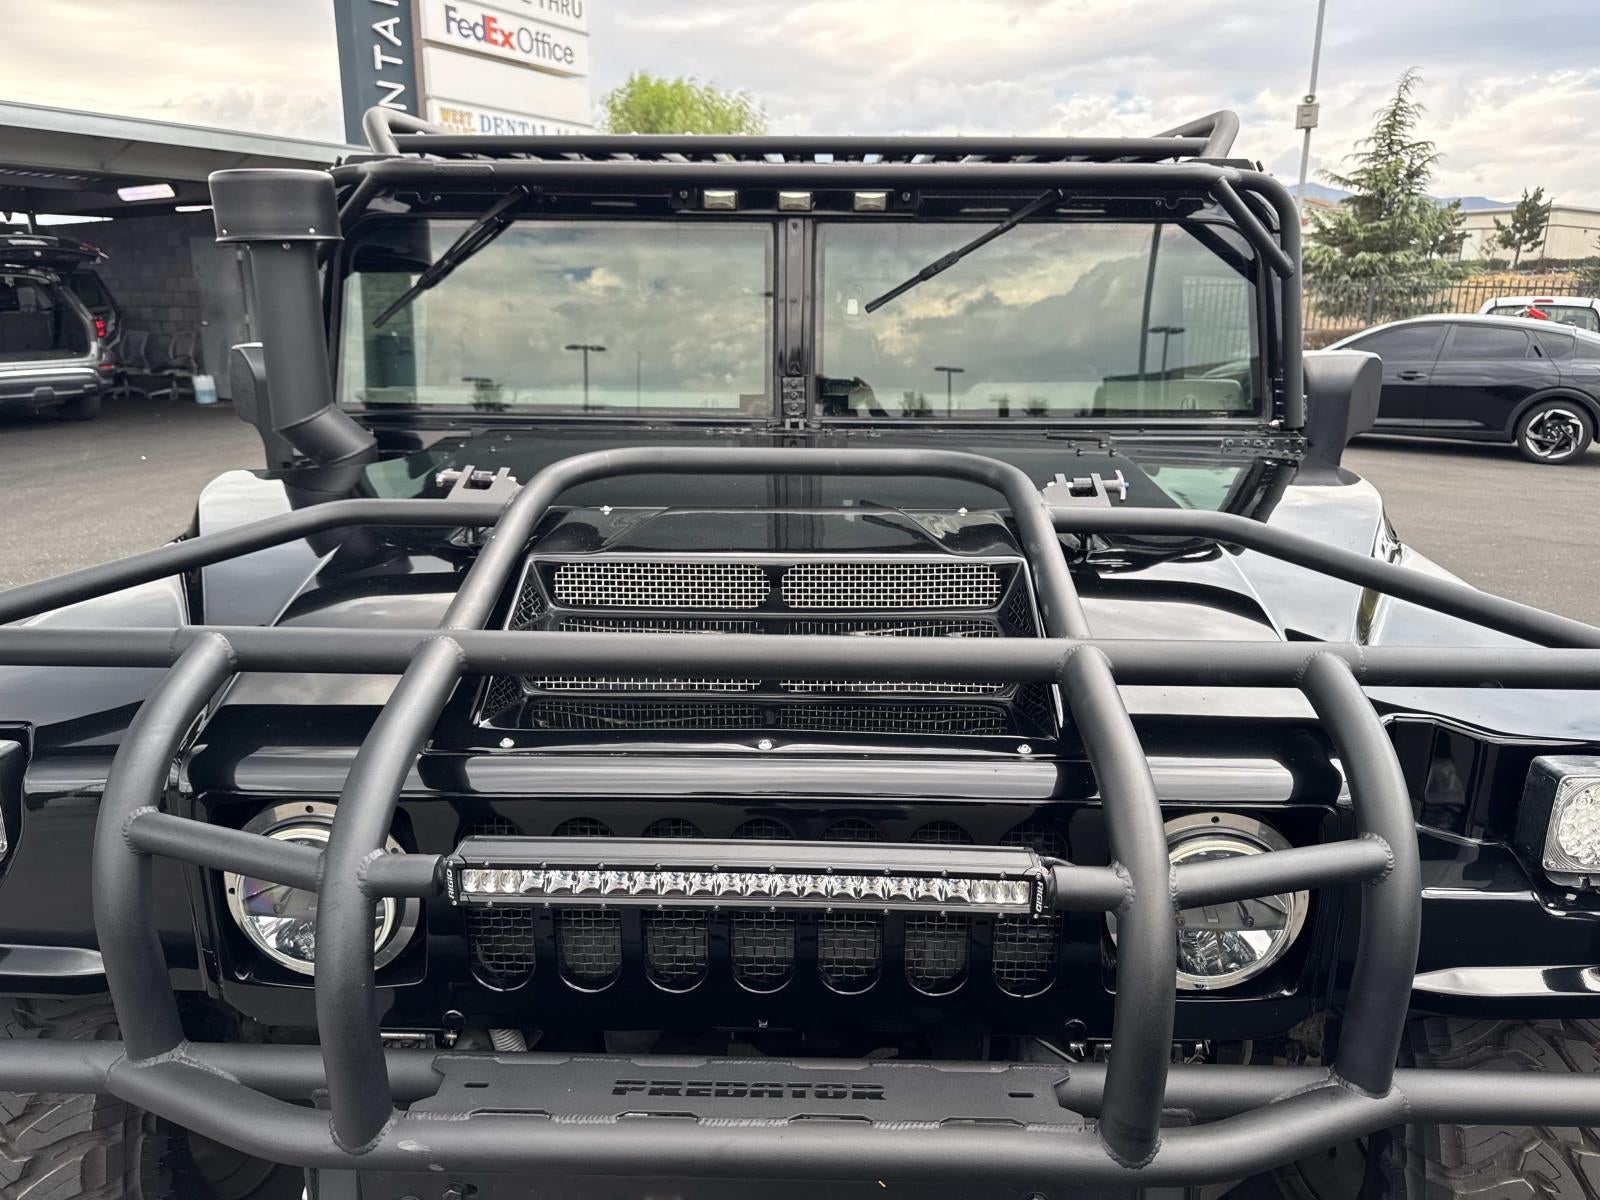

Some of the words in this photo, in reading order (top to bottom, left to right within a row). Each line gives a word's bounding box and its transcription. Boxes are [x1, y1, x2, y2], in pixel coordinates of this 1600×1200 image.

[444, 5, 516, 50] FedEx
[517, 27, 575, 64] Office
[446, 868, 454, 899] RIGID
[1035, 881, 1044, 912] RIGID
[611, 1079, 887, 1100] PREDATOR
